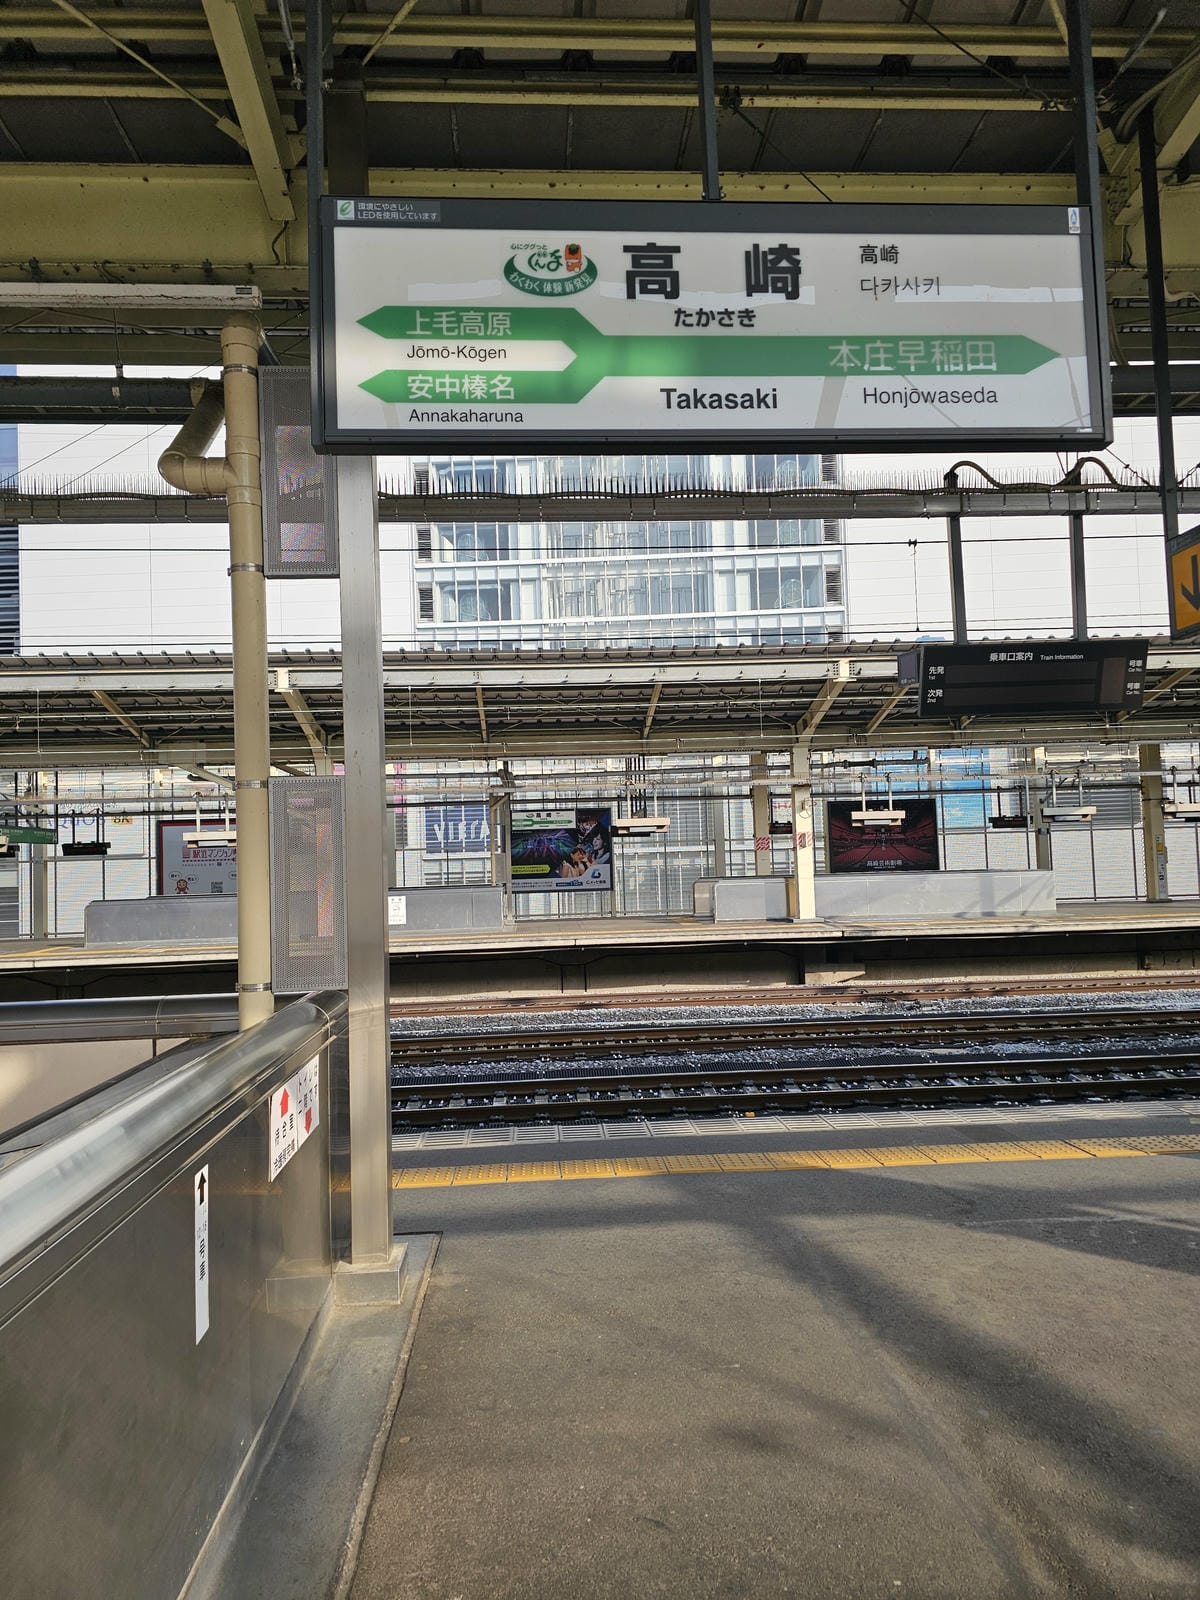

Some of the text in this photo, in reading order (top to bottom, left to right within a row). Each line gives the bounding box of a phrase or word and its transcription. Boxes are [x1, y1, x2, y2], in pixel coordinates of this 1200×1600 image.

[357, 202, 413, 212] 環境にやさしい
[357, 211, 437, 220] LEDを使用しています
[859, 245, 900, 264] 高崎
[623, 242, 802, 300] 高崎
[543, 281, 562, 294] 体験
[860, 276, 940, 297] 다카사키
[406, 310, 512, 336] 上毛高原
[674, 307, 757, 329] たかさき
[406, 345, 507, 361] Jōmō-Kōgen
[829, 340, 997, 372] 本庄早稲田
[407, 374, 515, 400] 安中榛名
[660, 388, 778, 409] Takasaki
[863, 387, 998, 408] Honjōwaseda
[409, 409, 524, 423] Annakaharuna
[929, 666, 945, 674] 先発
[927, 689, 943, 697] 次発
